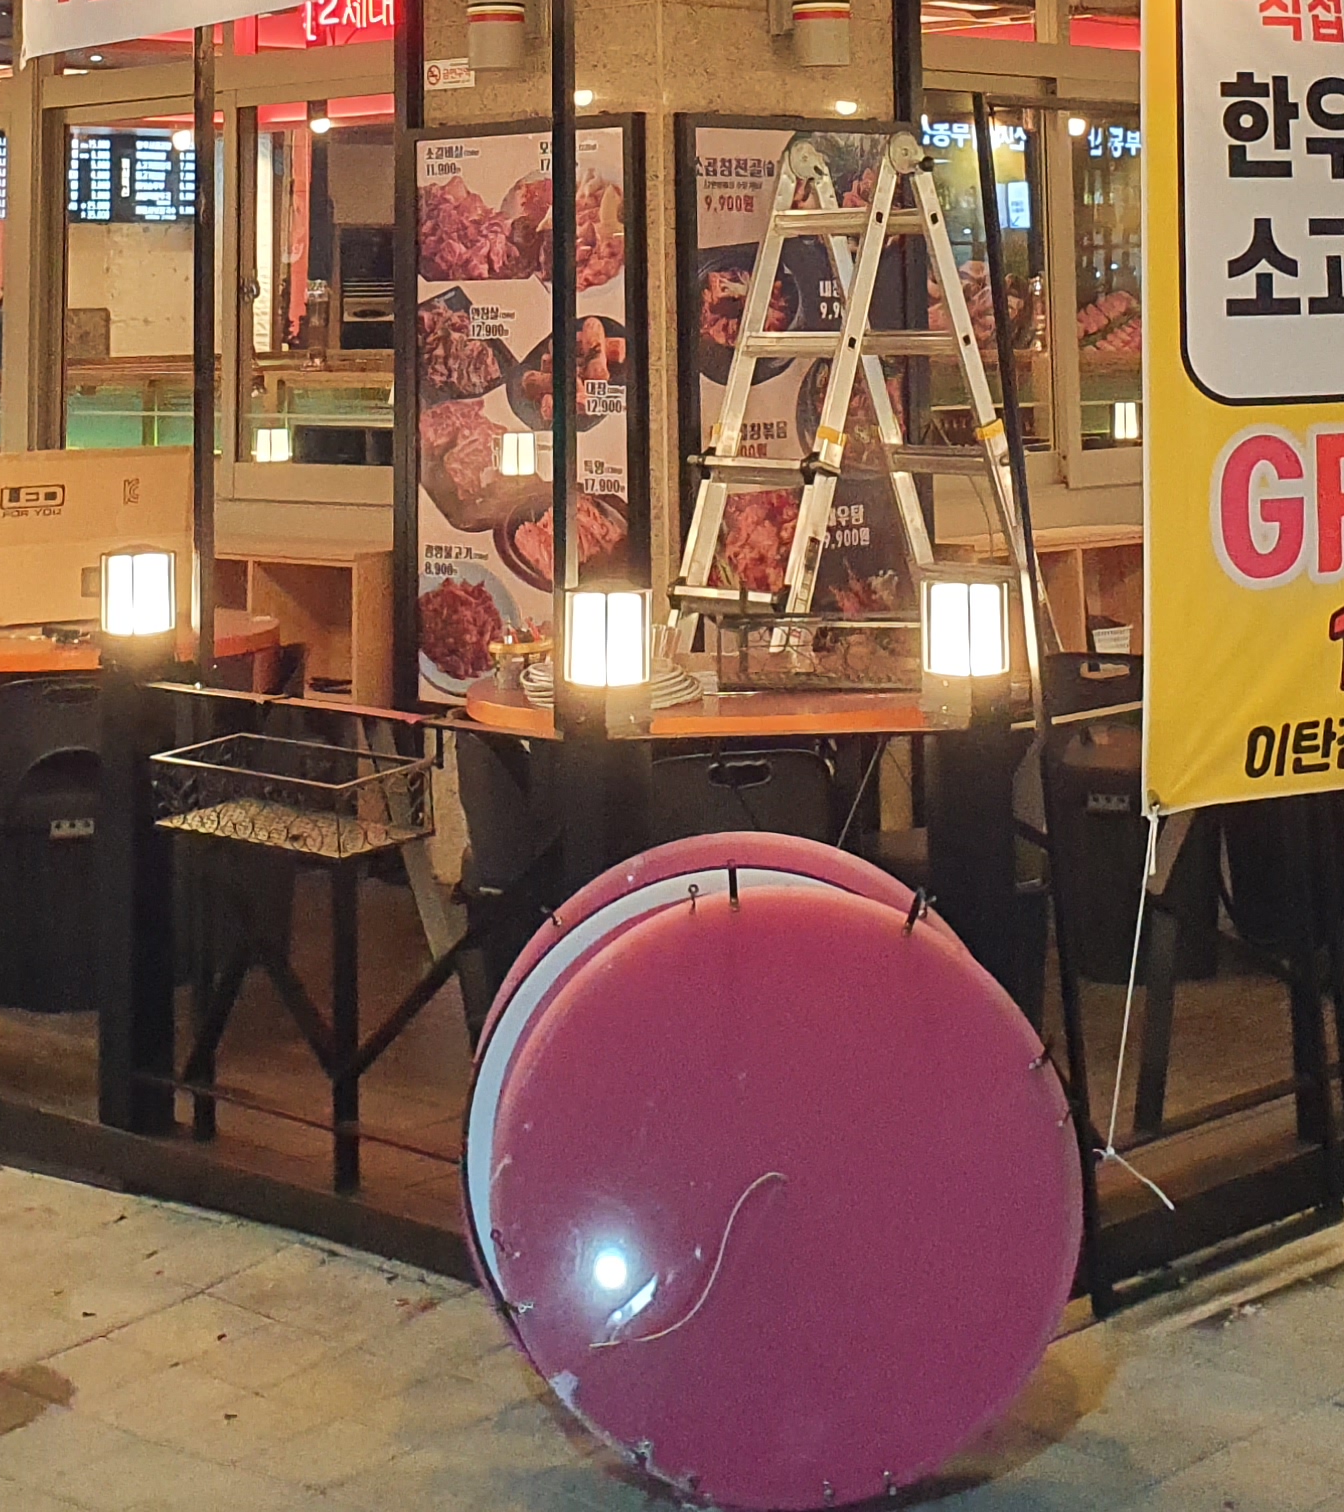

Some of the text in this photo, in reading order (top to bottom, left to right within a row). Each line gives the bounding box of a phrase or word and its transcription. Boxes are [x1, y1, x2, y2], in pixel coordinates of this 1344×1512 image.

[4, 486, 62, 506] LED
[2, 506, 63, 519] FOR YOU
